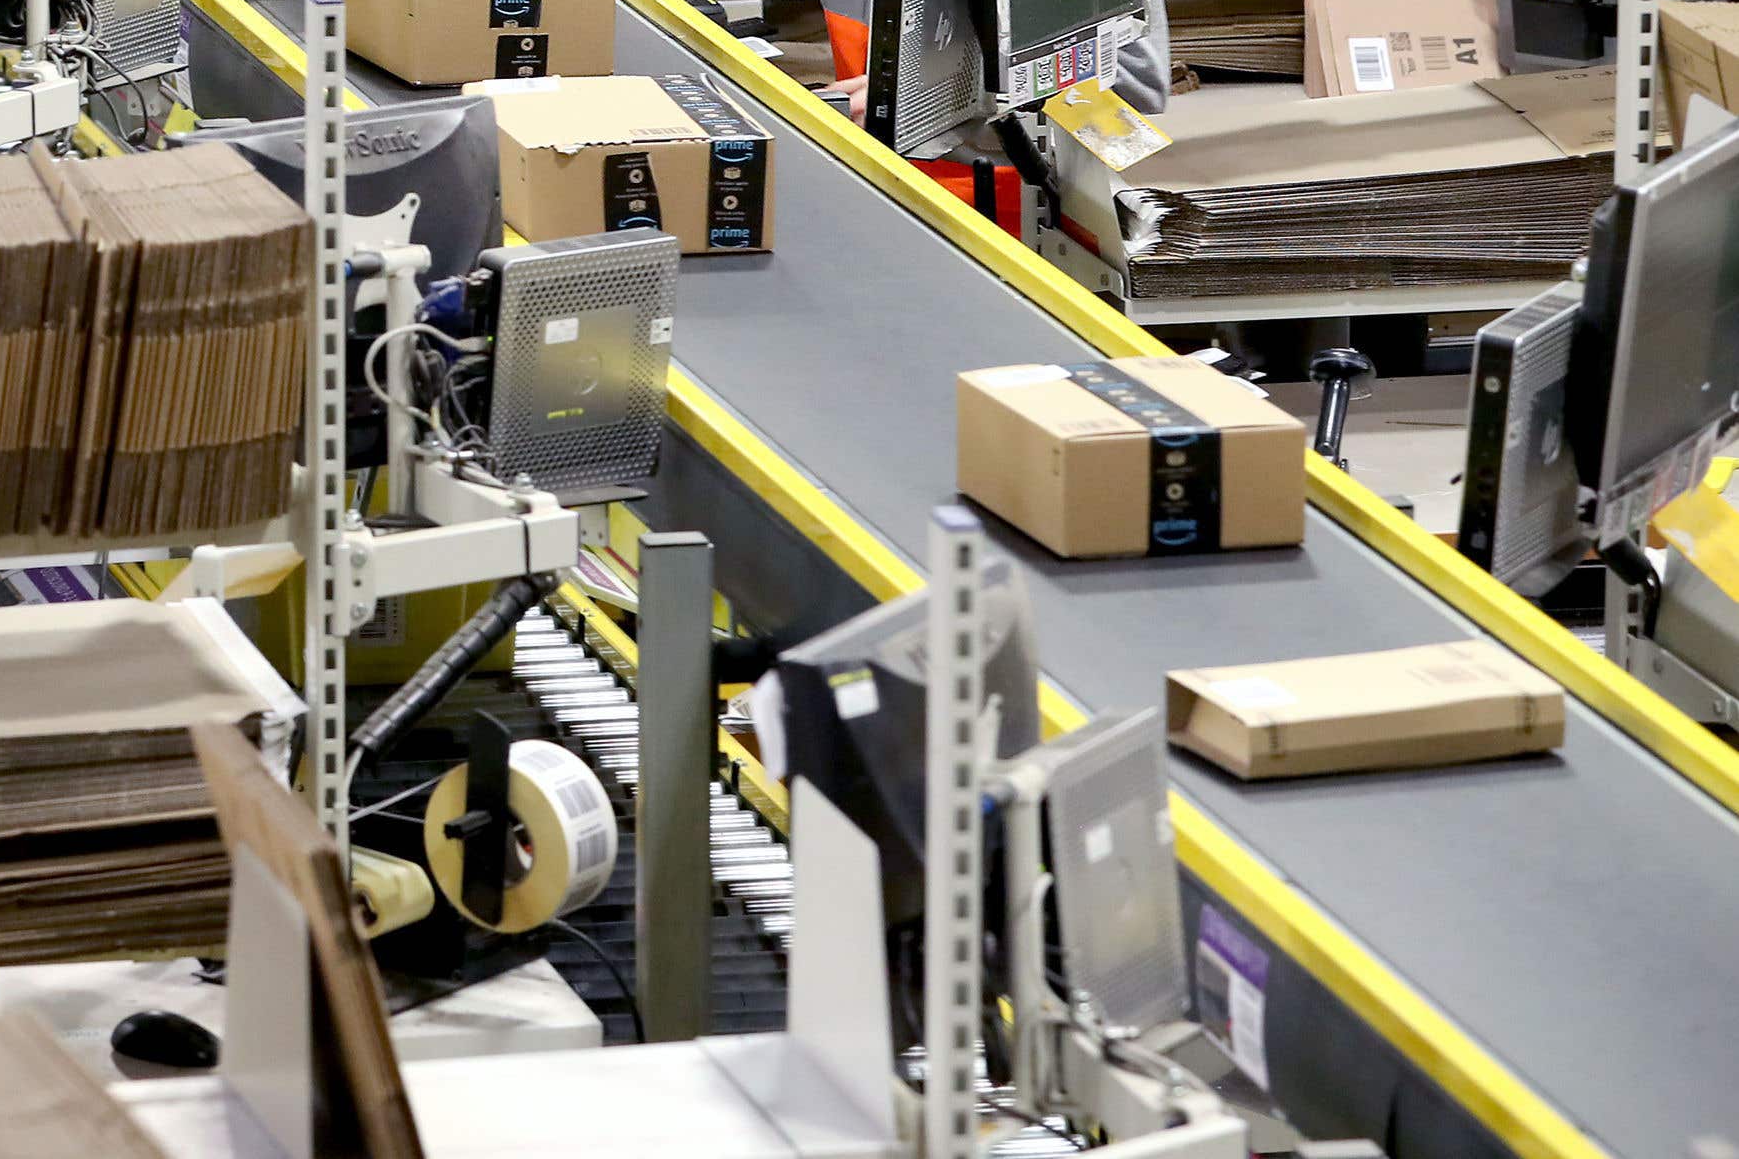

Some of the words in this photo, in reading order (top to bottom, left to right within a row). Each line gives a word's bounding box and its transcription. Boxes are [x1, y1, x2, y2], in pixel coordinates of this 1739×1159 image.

[1453, 38, 1479, 66] A1
[715, 140, 755, 152] prime
[710, 226, 751, 240] prime
